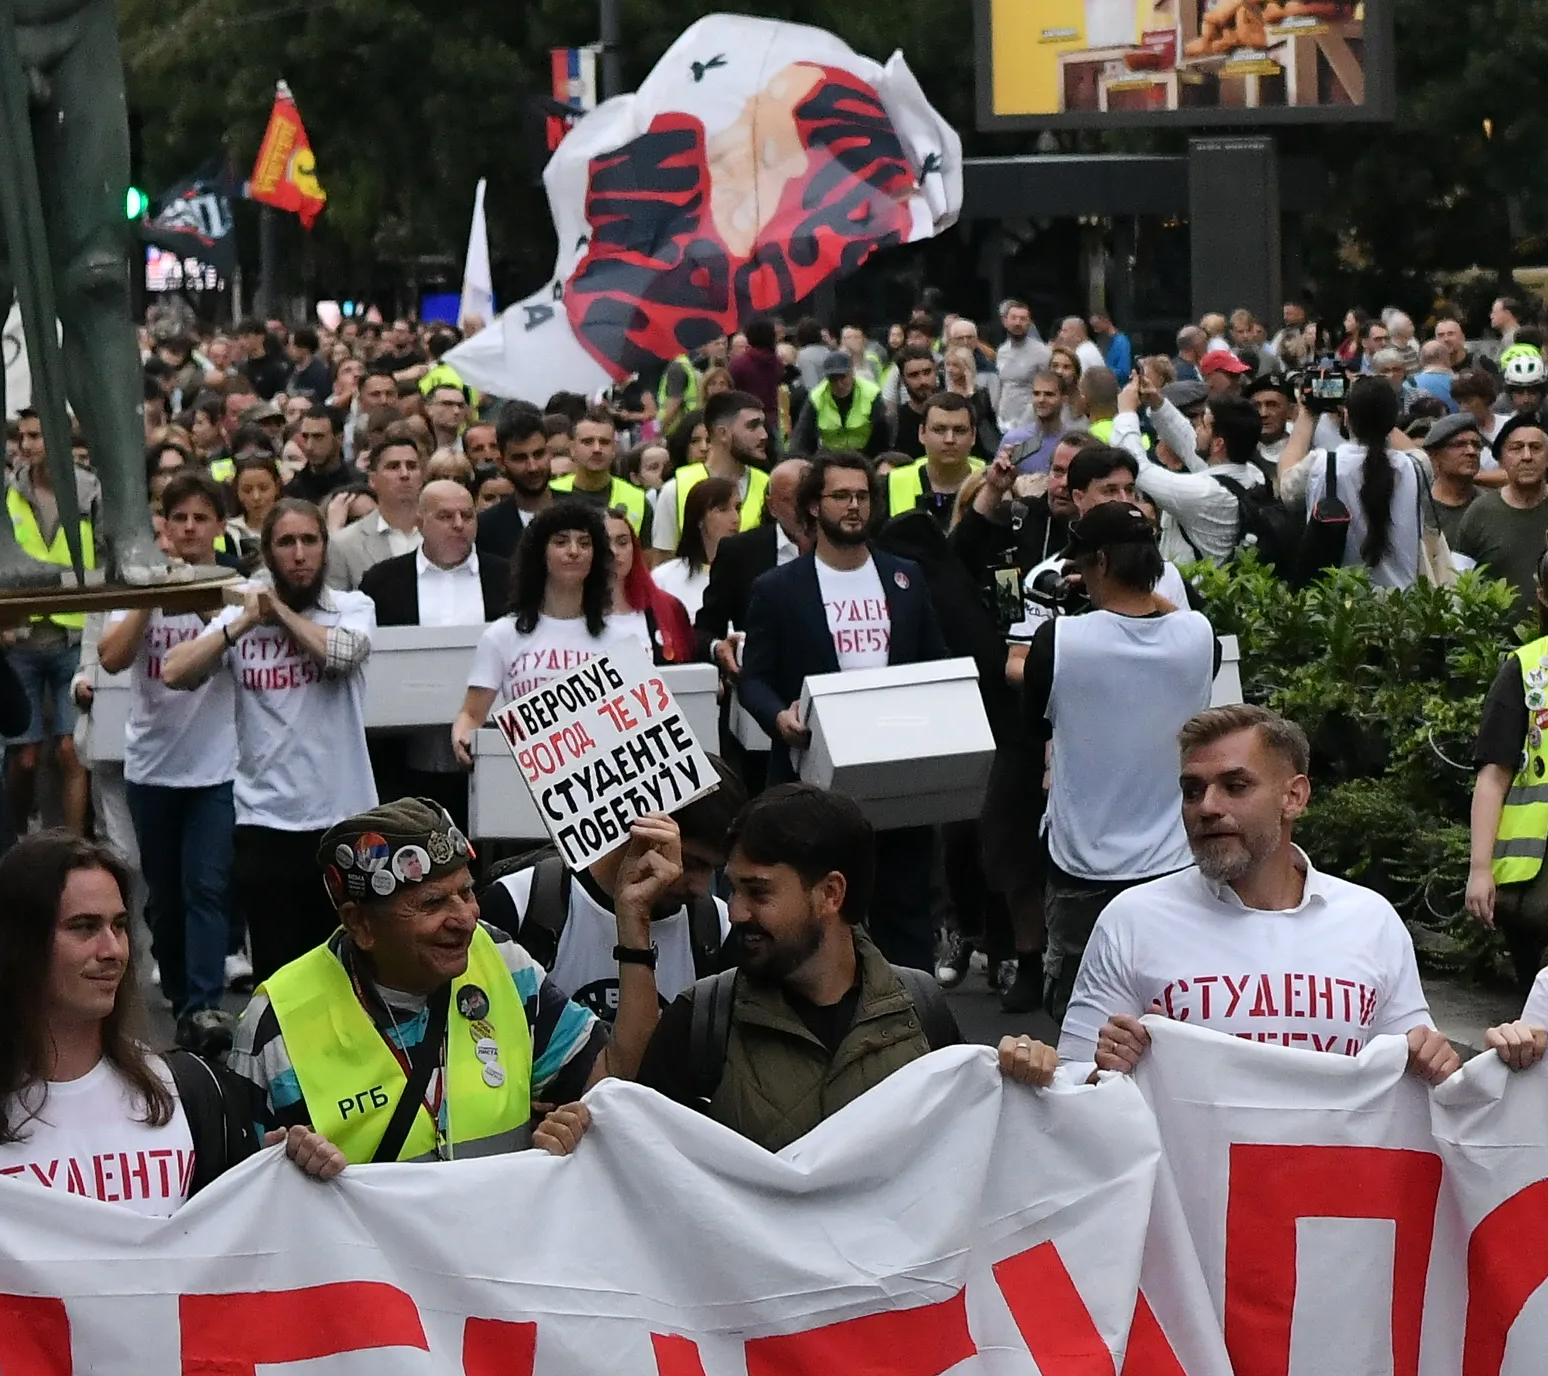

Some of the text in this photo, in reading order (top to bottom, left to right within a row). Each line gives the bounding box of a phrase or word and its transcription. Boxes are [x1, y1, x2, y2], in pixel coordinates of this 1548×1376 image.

[498, 709, 527, 747] И
[541, 714, 693, 822] СТУДЕНТЕ
[557, 755, 701, 865] ПОБЕЂУЈУ
[1163, 973, 1377, 1026] СТУДЕНТИ
[338, 1085, 389, 1120] РГБ
